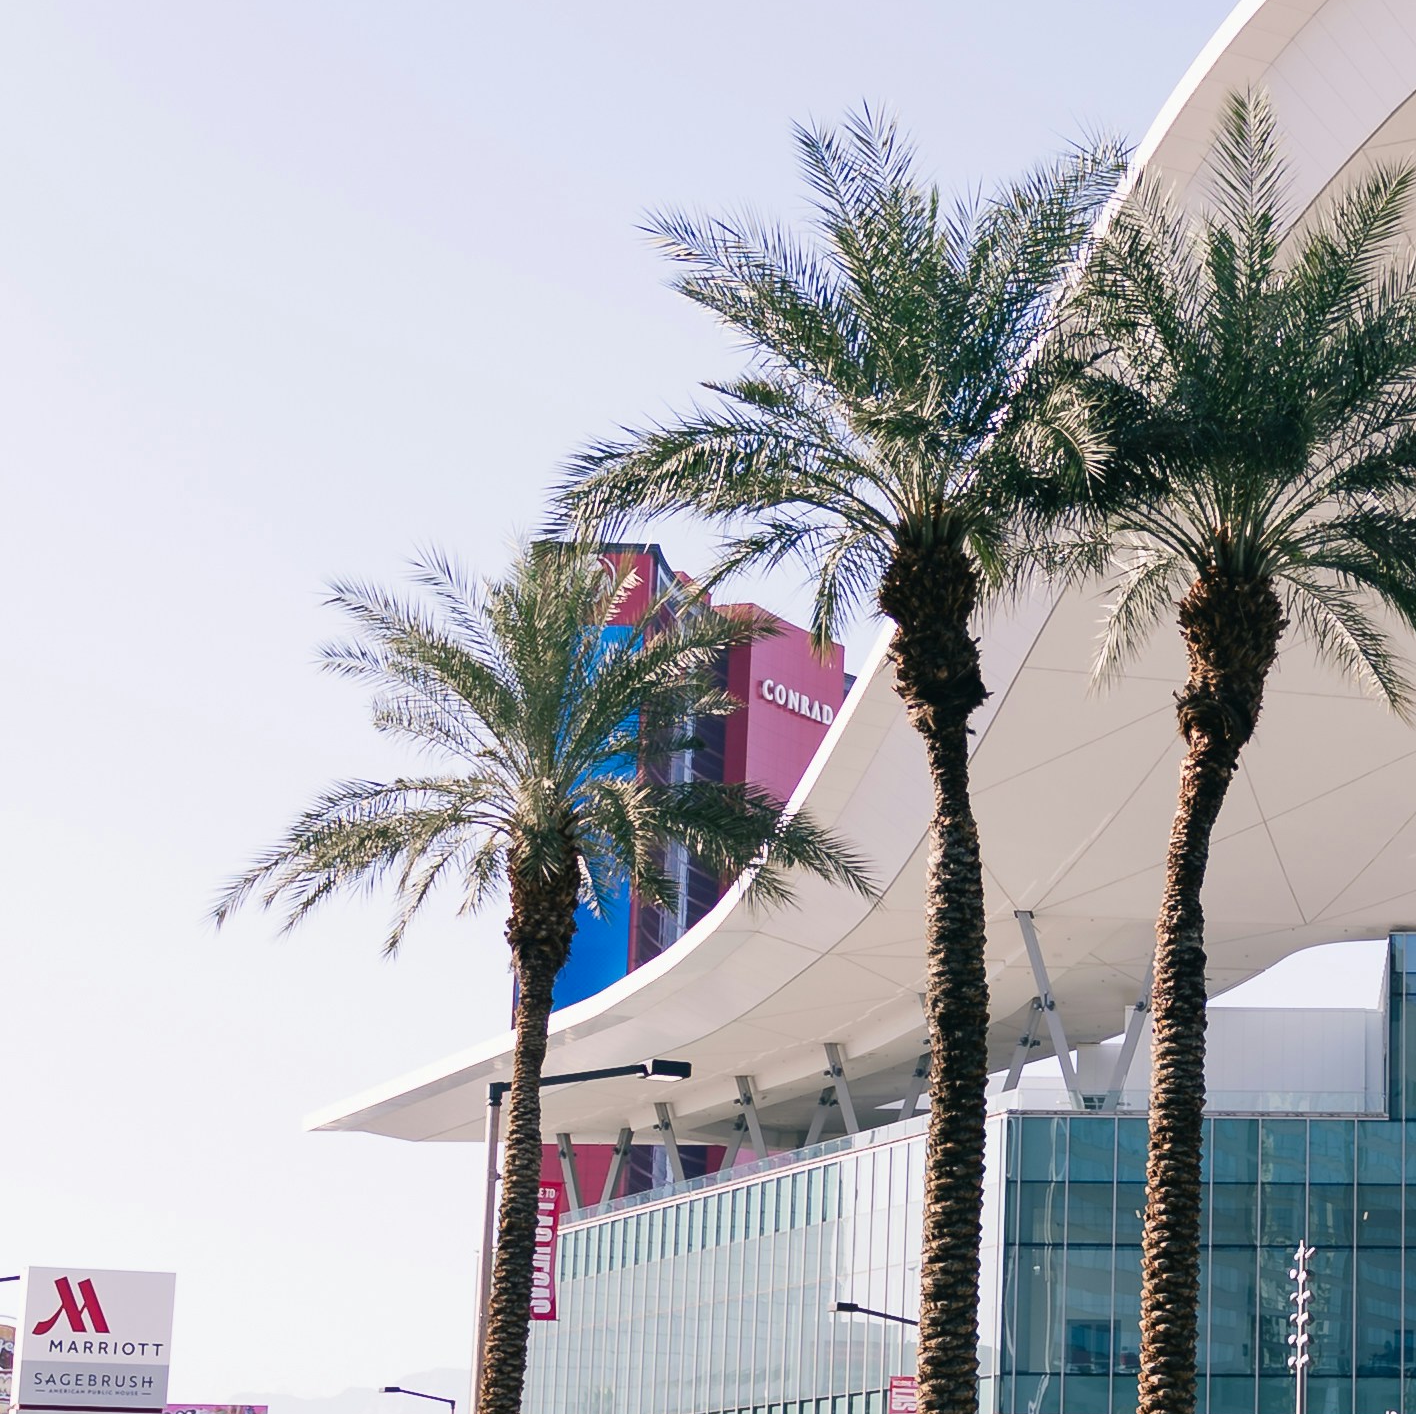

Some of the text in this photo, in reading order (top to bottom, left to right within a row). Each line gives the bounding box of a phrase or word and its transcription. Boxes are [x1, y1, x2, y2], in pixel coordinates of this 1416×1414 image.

[762, 679, 834, 726] CONRAD
[49, 1340, 164, 1357] MARRIOTT
[34, 1372, 153, 1388] SAGEBRUSH
[892, 1388, 917, 1411] LAS
